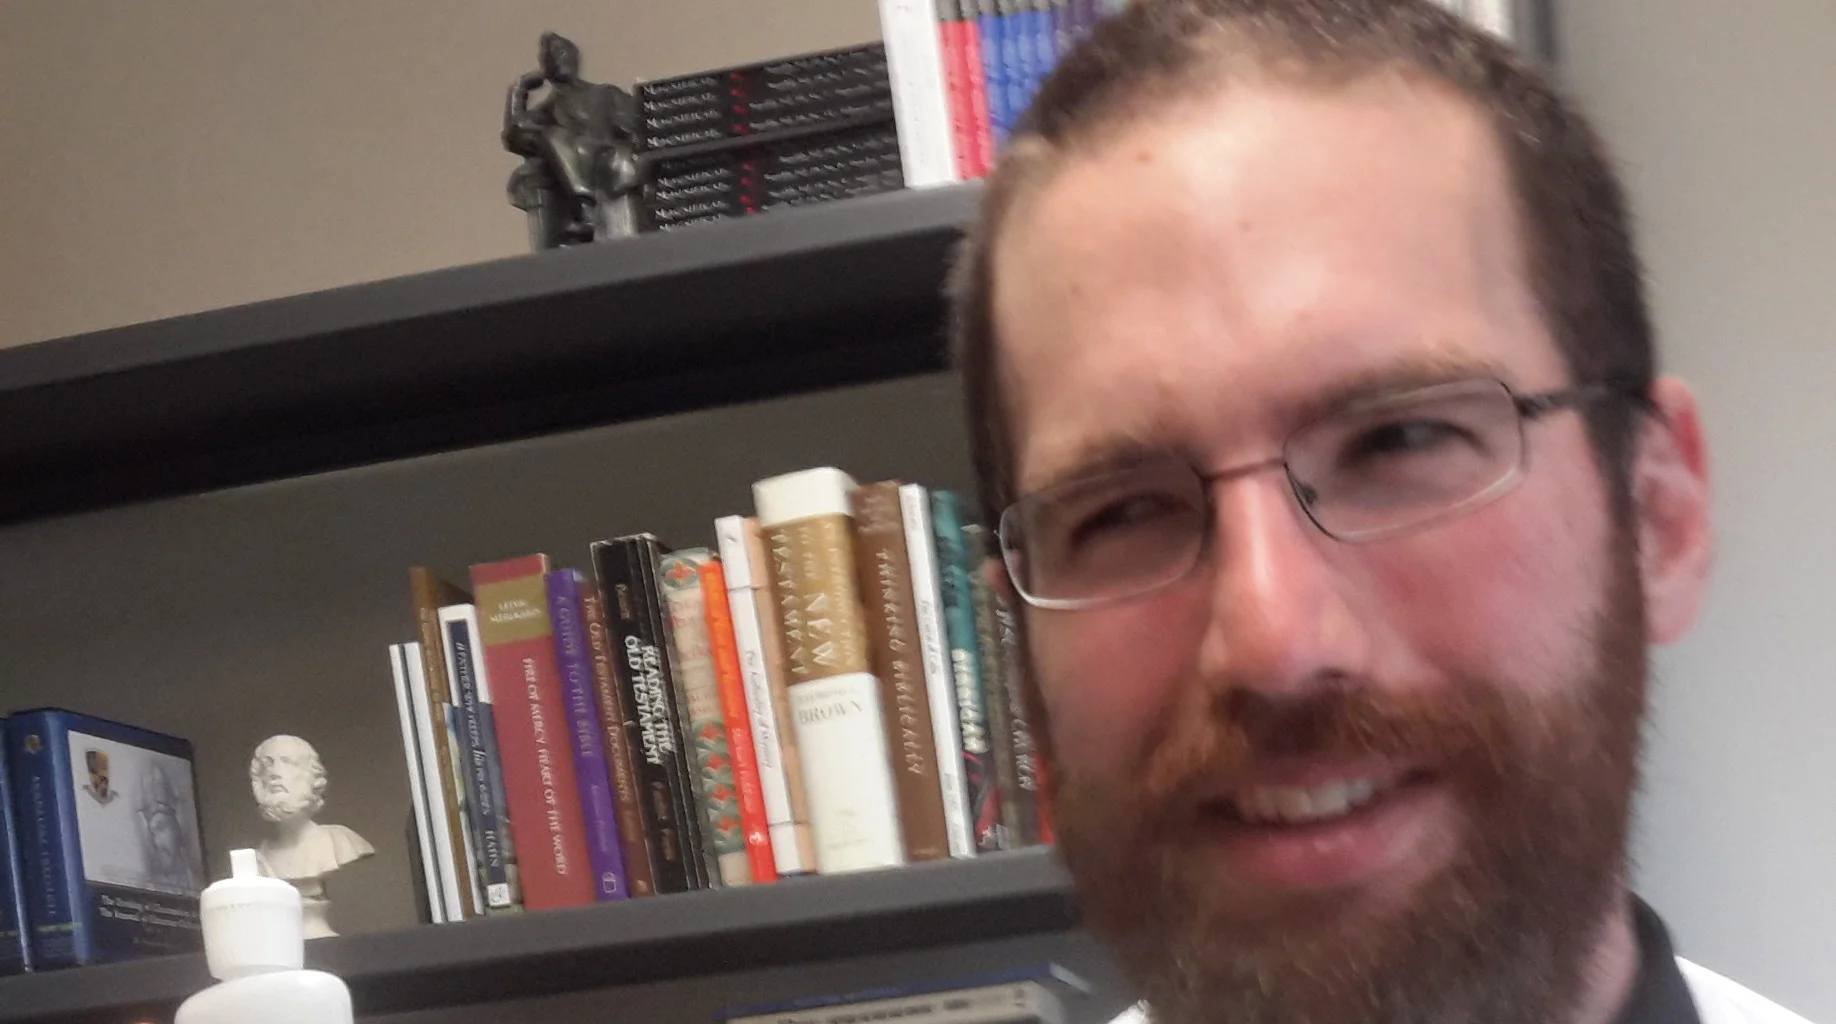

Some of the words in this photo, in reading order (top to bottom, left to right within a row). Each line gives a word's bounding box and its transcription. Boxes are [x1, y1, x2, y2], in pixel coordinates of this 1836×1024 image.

[522, 657, 537, 683] FIRE
[623, 634, 642, 670] OLD
[874, 548, 906, 653] THINKING
[890, 657, 924, 775] BIBLICALLY
[526, 683, 540, 700] OF
[640, 643, 668, 716] READING
[654, 718, 674, 755] THE
[630, 673, 660, 766] TESTAMENT
[799, 700, 862, 724] BROWN
[537, 748, 554, 786] HEART
[543, 787, 557, 806] OF
